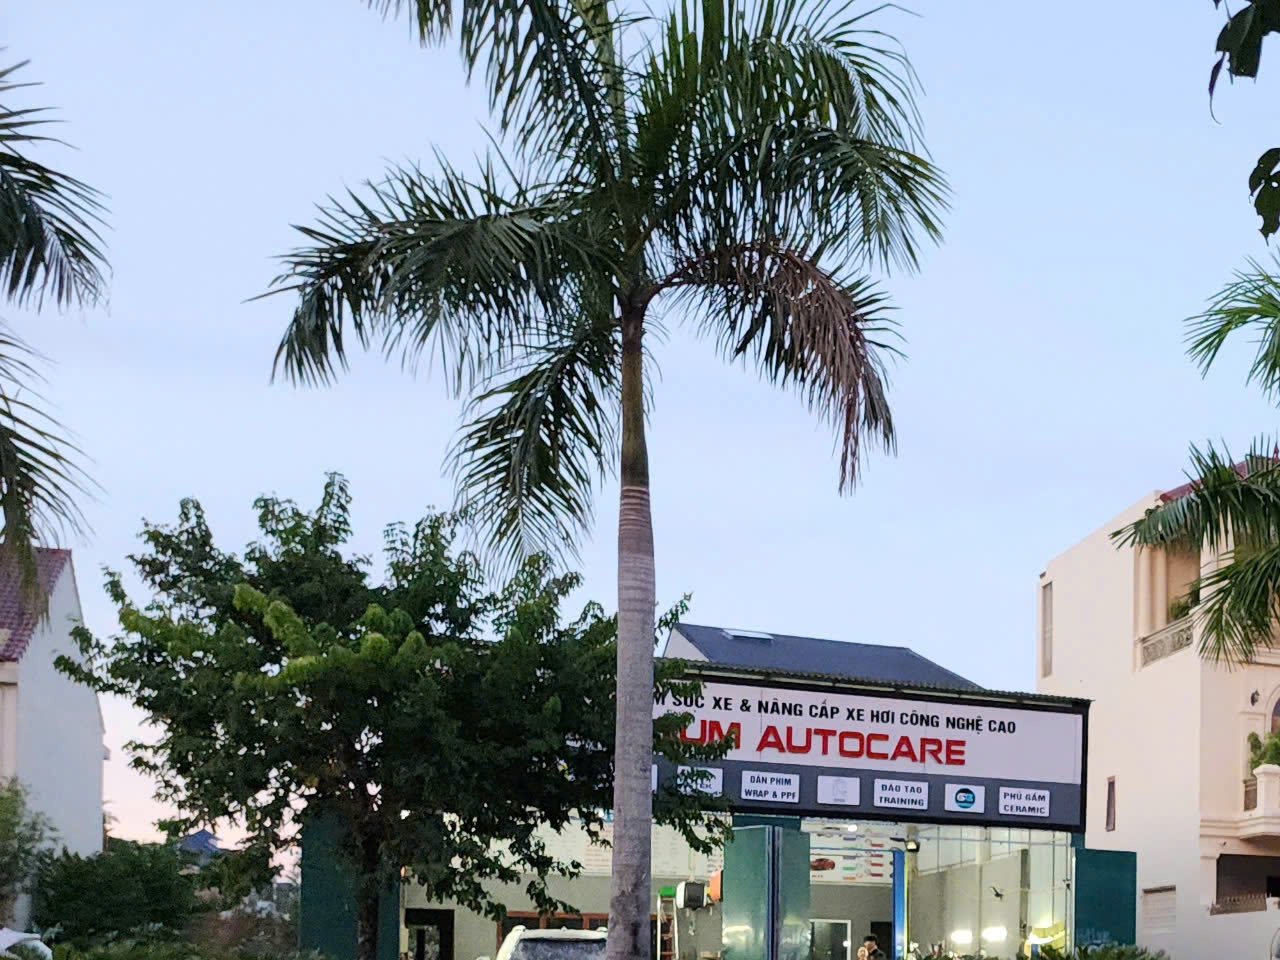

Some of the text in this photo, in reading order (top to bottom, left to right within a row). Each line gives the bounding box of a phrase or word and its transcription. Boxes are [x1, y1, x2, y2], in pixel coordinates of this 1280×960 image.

[712, 696, 733, 711] XE
[739, 698, 752, 713] &
[758, 697, 804, 717] NÂNG
[808, 698, 840, 720] CẤP
[846, 707, 865, 722] XE
[870, 709, 896, 725] HƠI
[900, 709, 941, 728] CÔNG
[946, 715, 984, 735] NGHỆ
[988, 719, 1017, 734] CAO
[756, 724, 966, 766] AUTOCARE
[770, 777, 792, 786] PHIM
[744, 788, 797, 800] WRAP & PPF
[879, 796, 925, 807] TRAINING
[1003, 804, 1046, 814] CERAMIC
